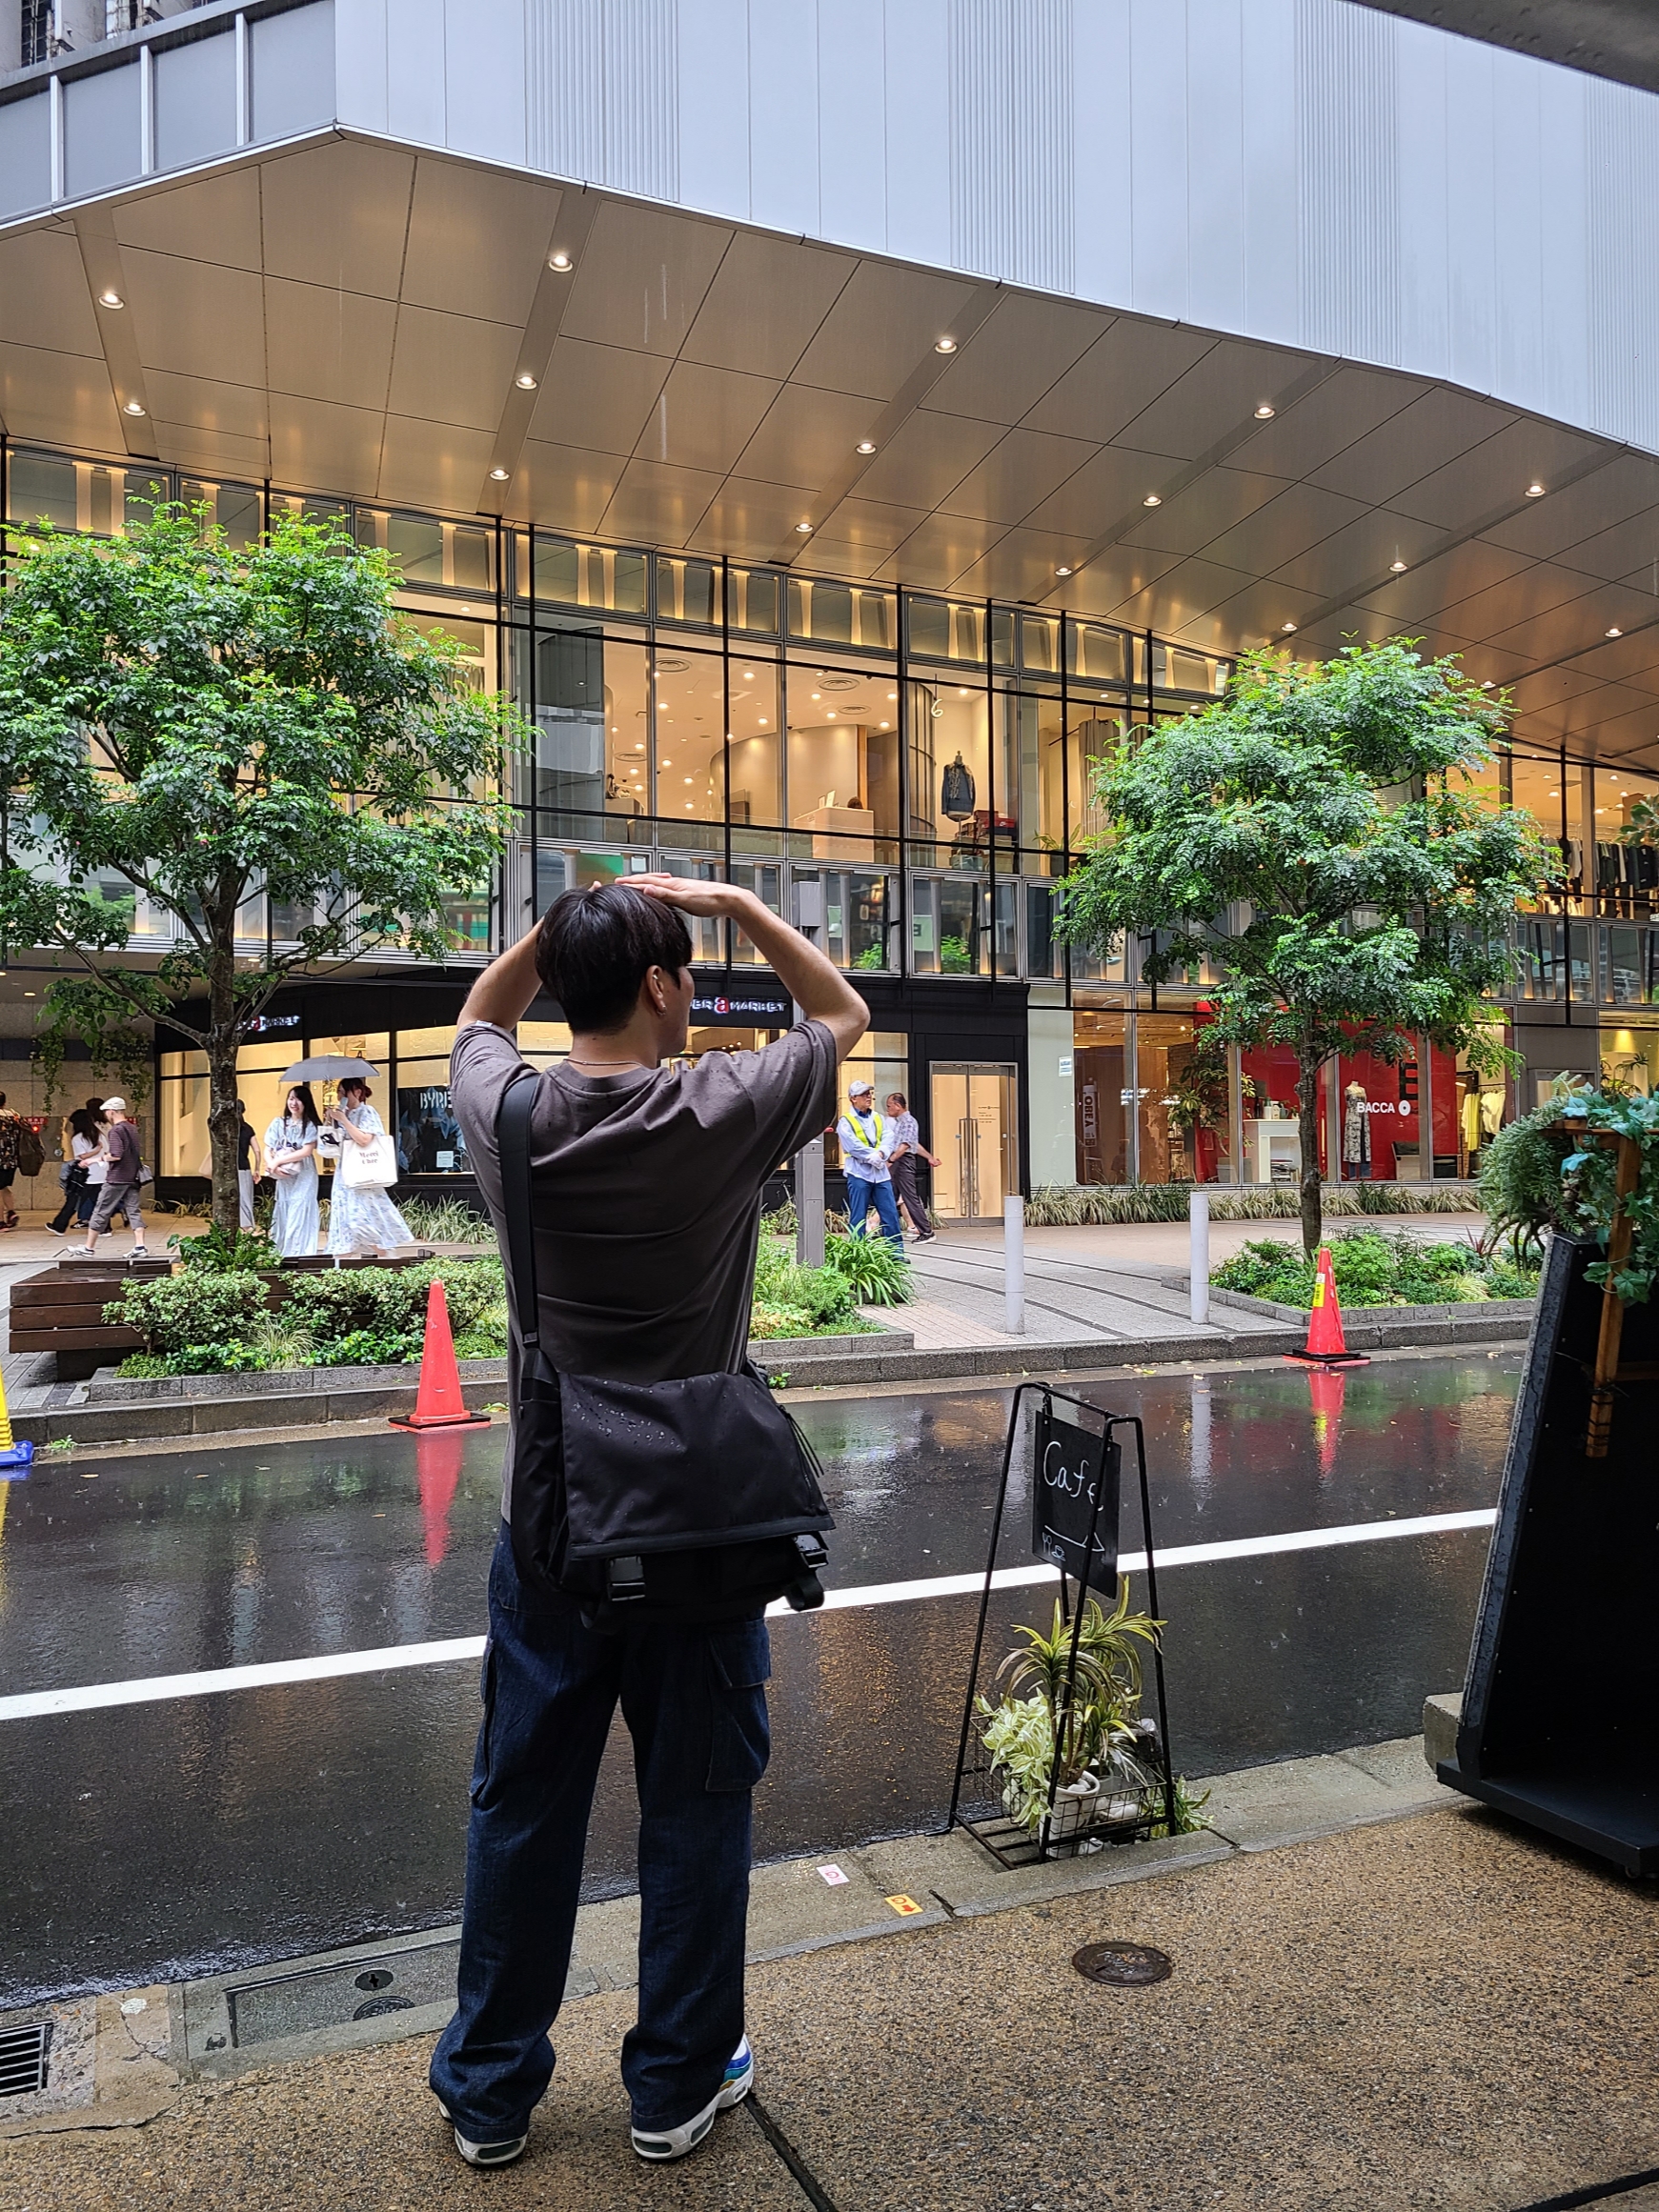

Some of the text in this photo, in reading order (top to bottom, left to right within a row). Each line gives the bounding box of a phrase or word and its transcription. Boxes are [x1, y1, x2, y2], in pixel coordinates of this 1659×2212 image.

[714, 996, 729, 1014] a
[730, 1001, 787, 1013] MARKET
[1356, 1102, 1395, 1114] BACCA
